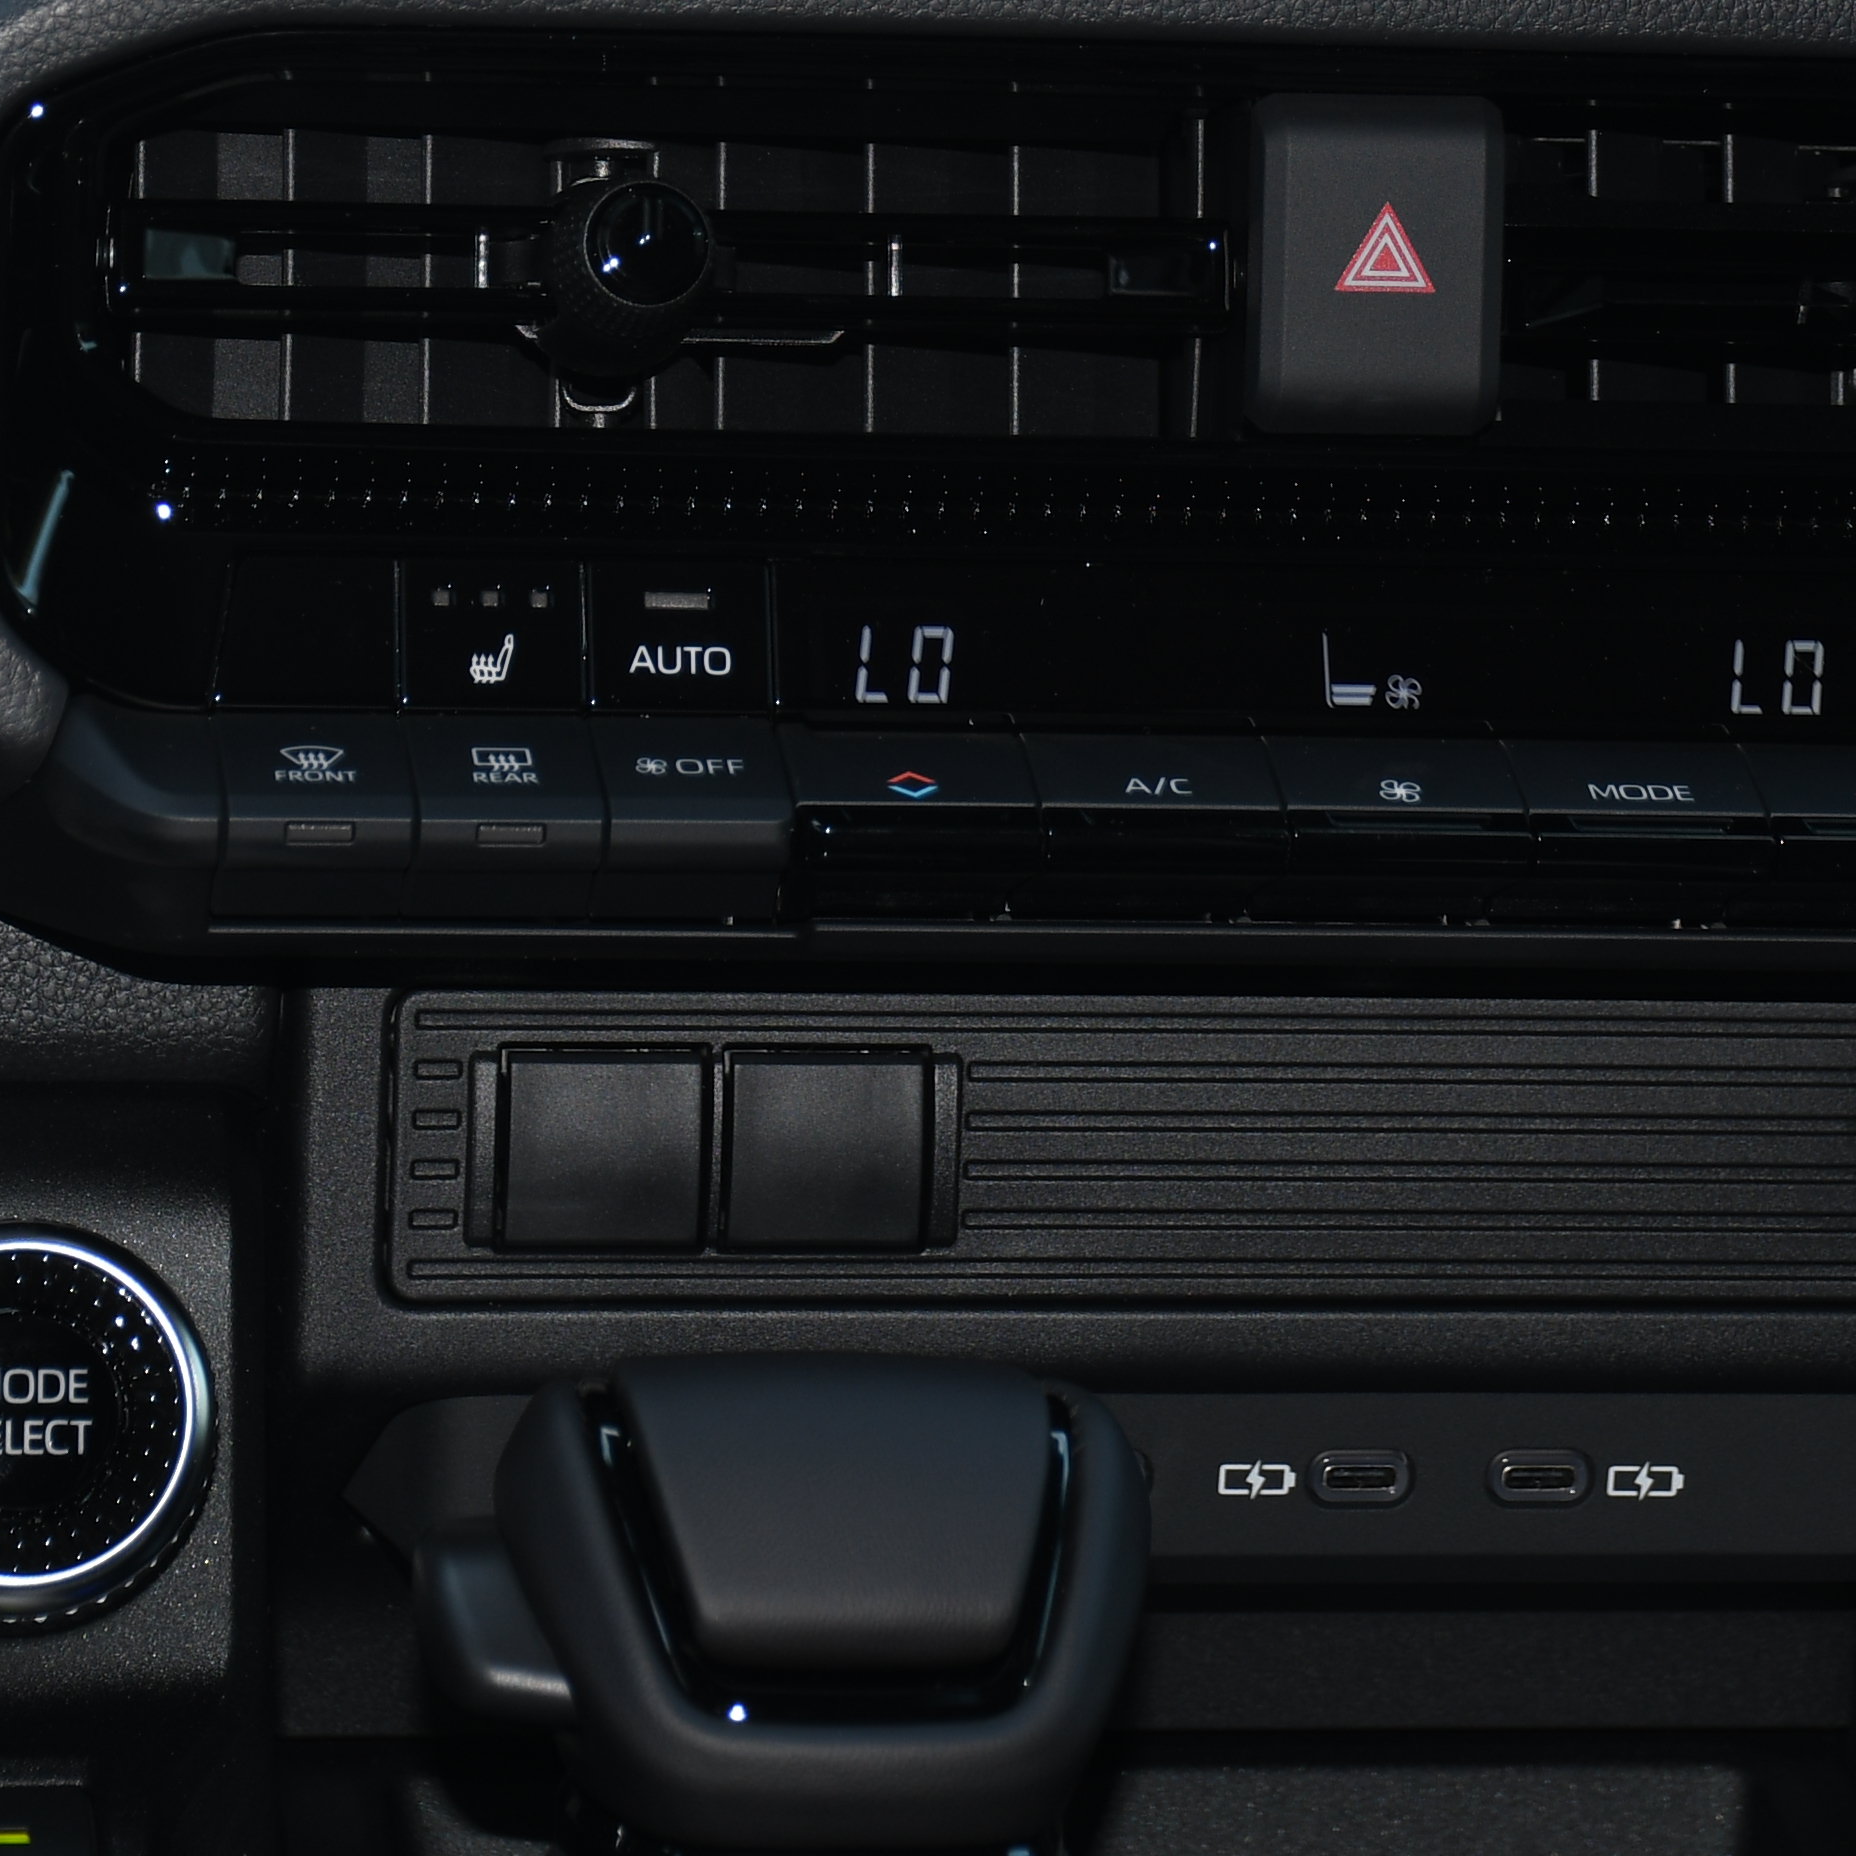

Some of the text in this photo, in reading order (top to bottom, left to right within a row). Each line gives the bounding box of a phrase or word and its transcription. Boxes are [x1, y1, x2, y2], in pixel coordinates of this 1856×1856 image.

[629, 645, 731, 676] AUTO
[675, 758, 744, 775] OFF
[275, 770, 356, 783] FRONT
[473, 772, 539, 783] REAR
[1124, 777, 1192, 796] A/C
[1587, 784, 1695, 803] MODE
